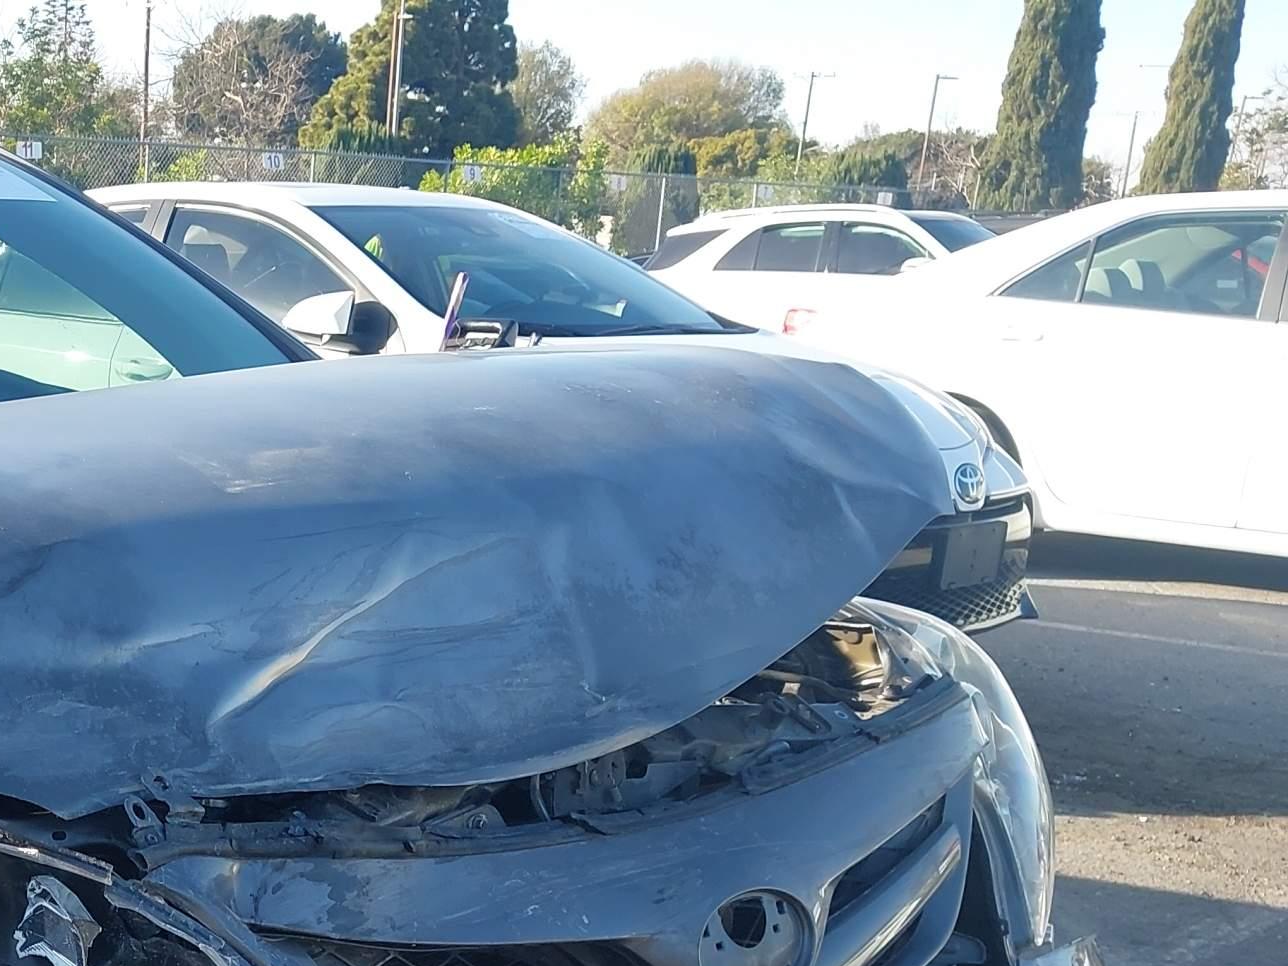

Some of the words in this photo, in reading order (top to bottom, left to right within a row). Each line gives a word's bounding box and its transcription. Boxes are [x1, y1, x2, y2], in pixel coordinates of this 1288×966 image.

[22, 142, 33, 158] 11
[267, 154, 281, 169] 10
[469, 167, 476, 180] 9
